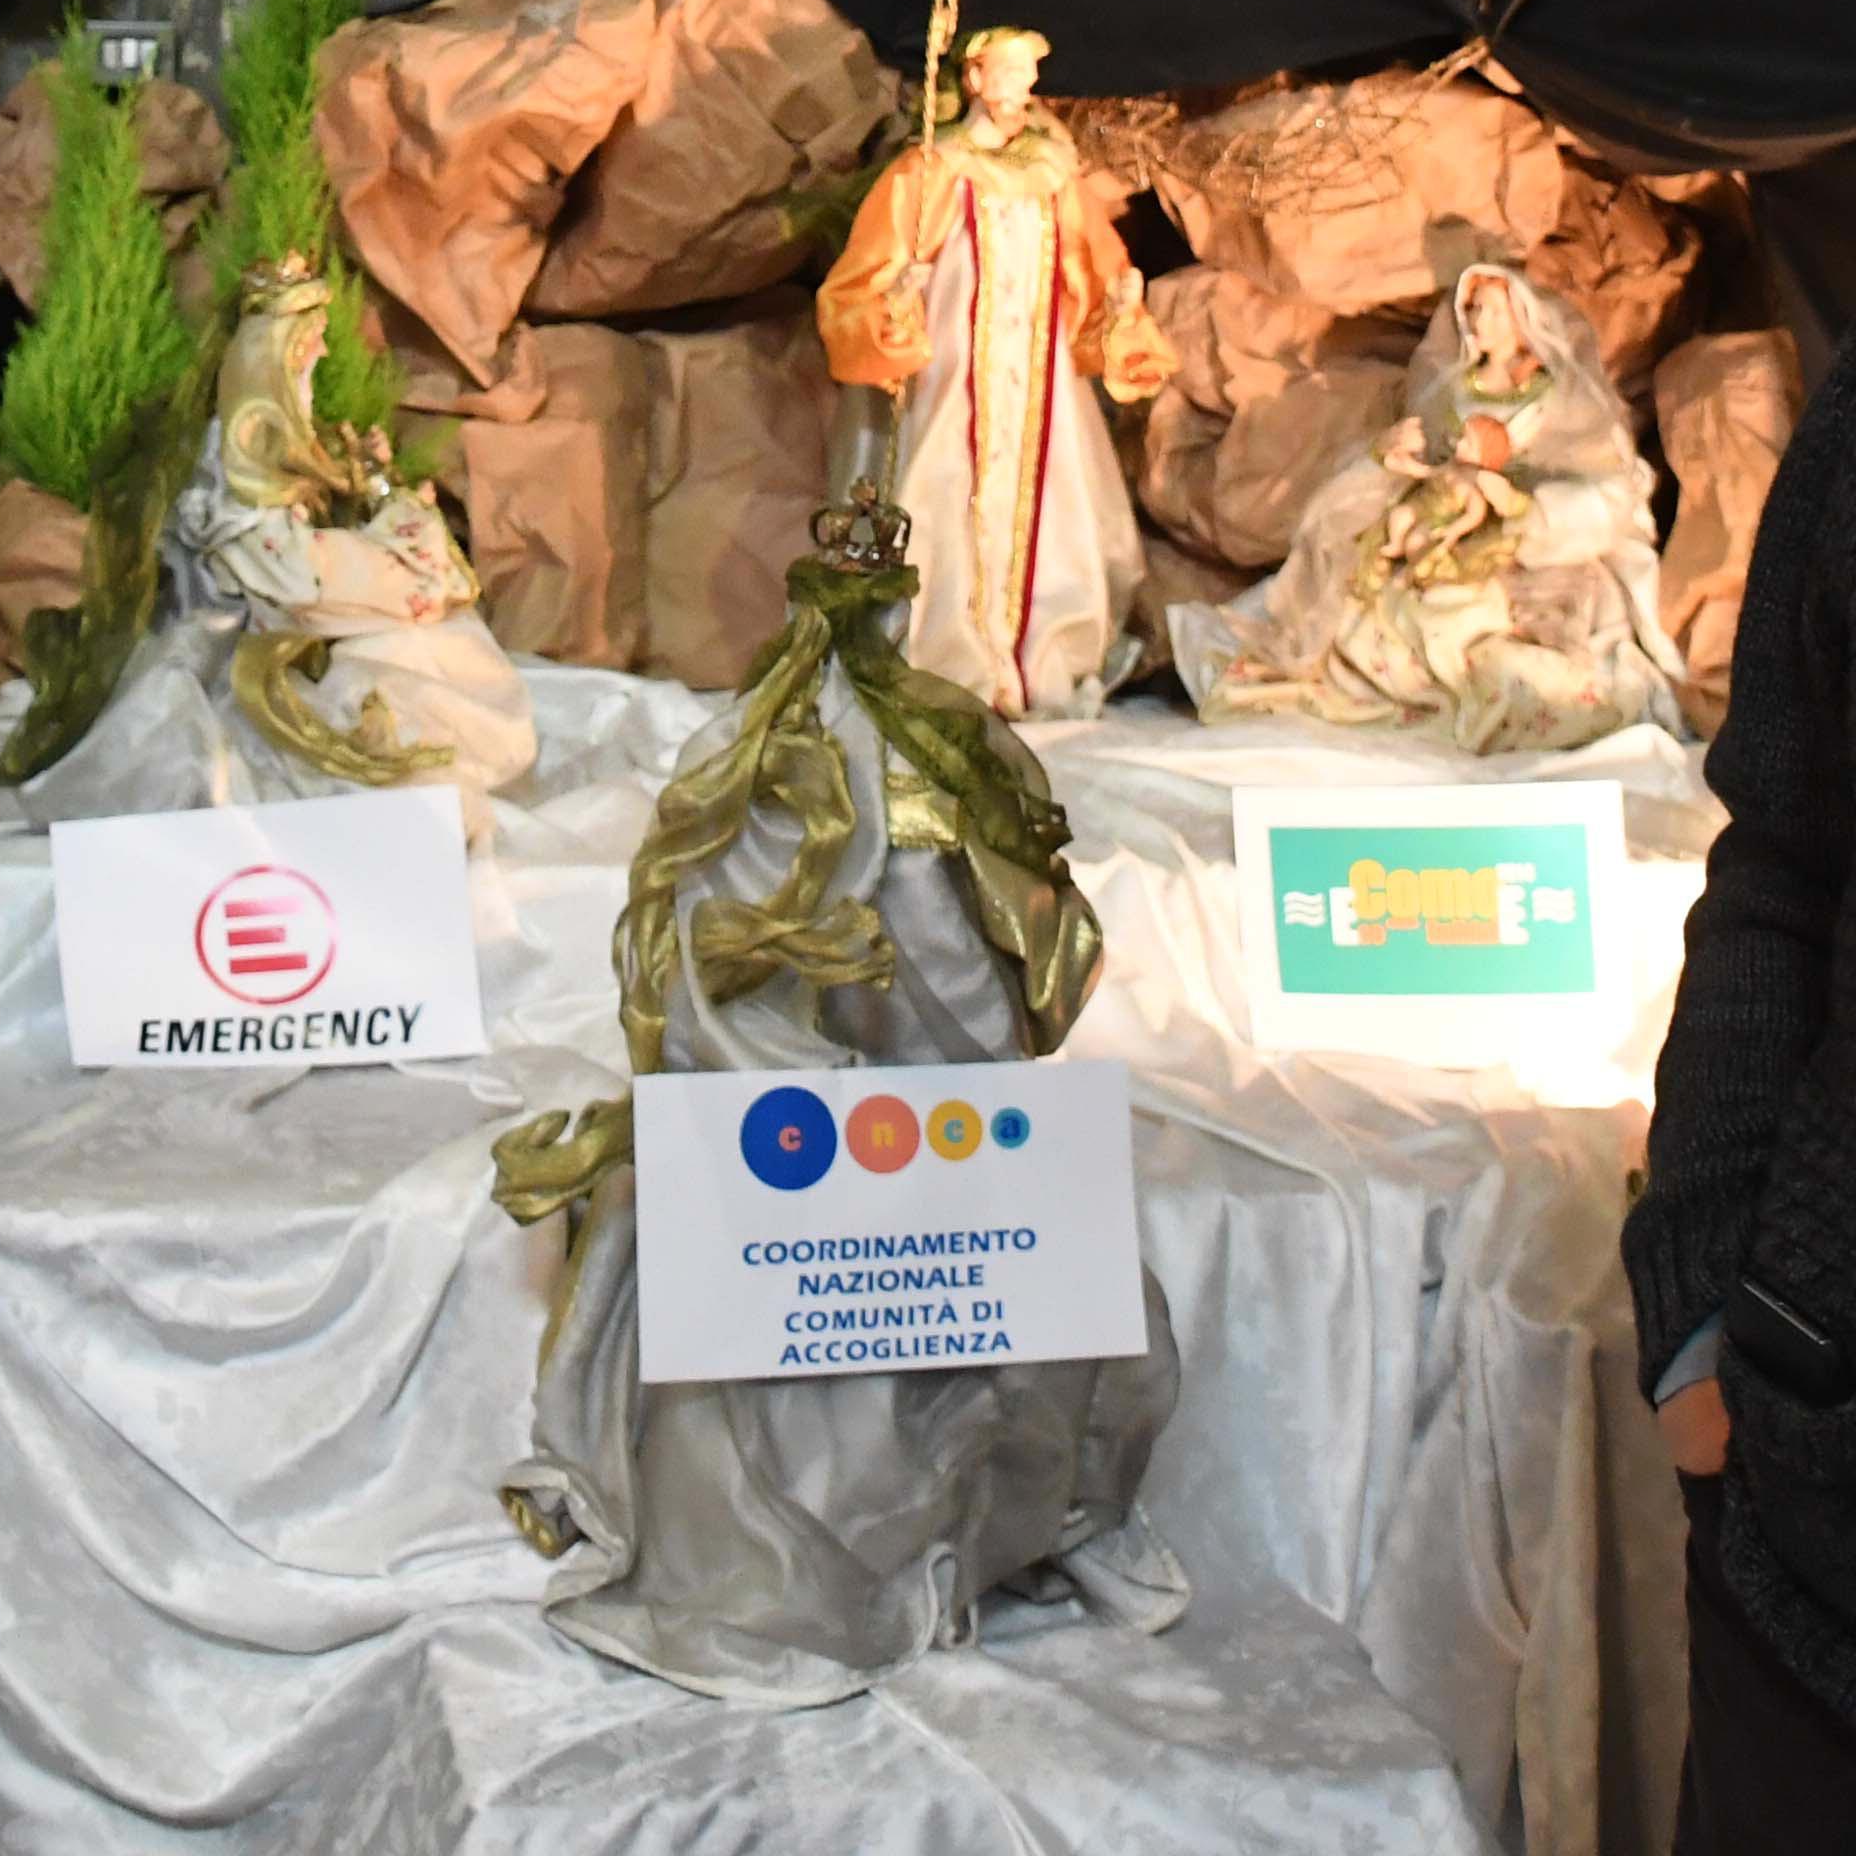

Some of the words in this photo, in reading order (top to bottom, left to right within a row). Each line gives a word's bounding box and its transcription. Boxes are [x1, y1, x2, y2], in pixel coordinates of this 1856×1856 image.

[137, 1001, 426, 1054] EMERGENCY
[741, 1227, 1038, 1267] COORDINAMENTO
[797, 1263, 985, 1297] NAZIONALE
[783, 1299, 959, 1334] COMUNITÀ
[971, 1299, 1004, 1323] DI
[779, 1330, 1012, 1365] ACCOGLIENZA
